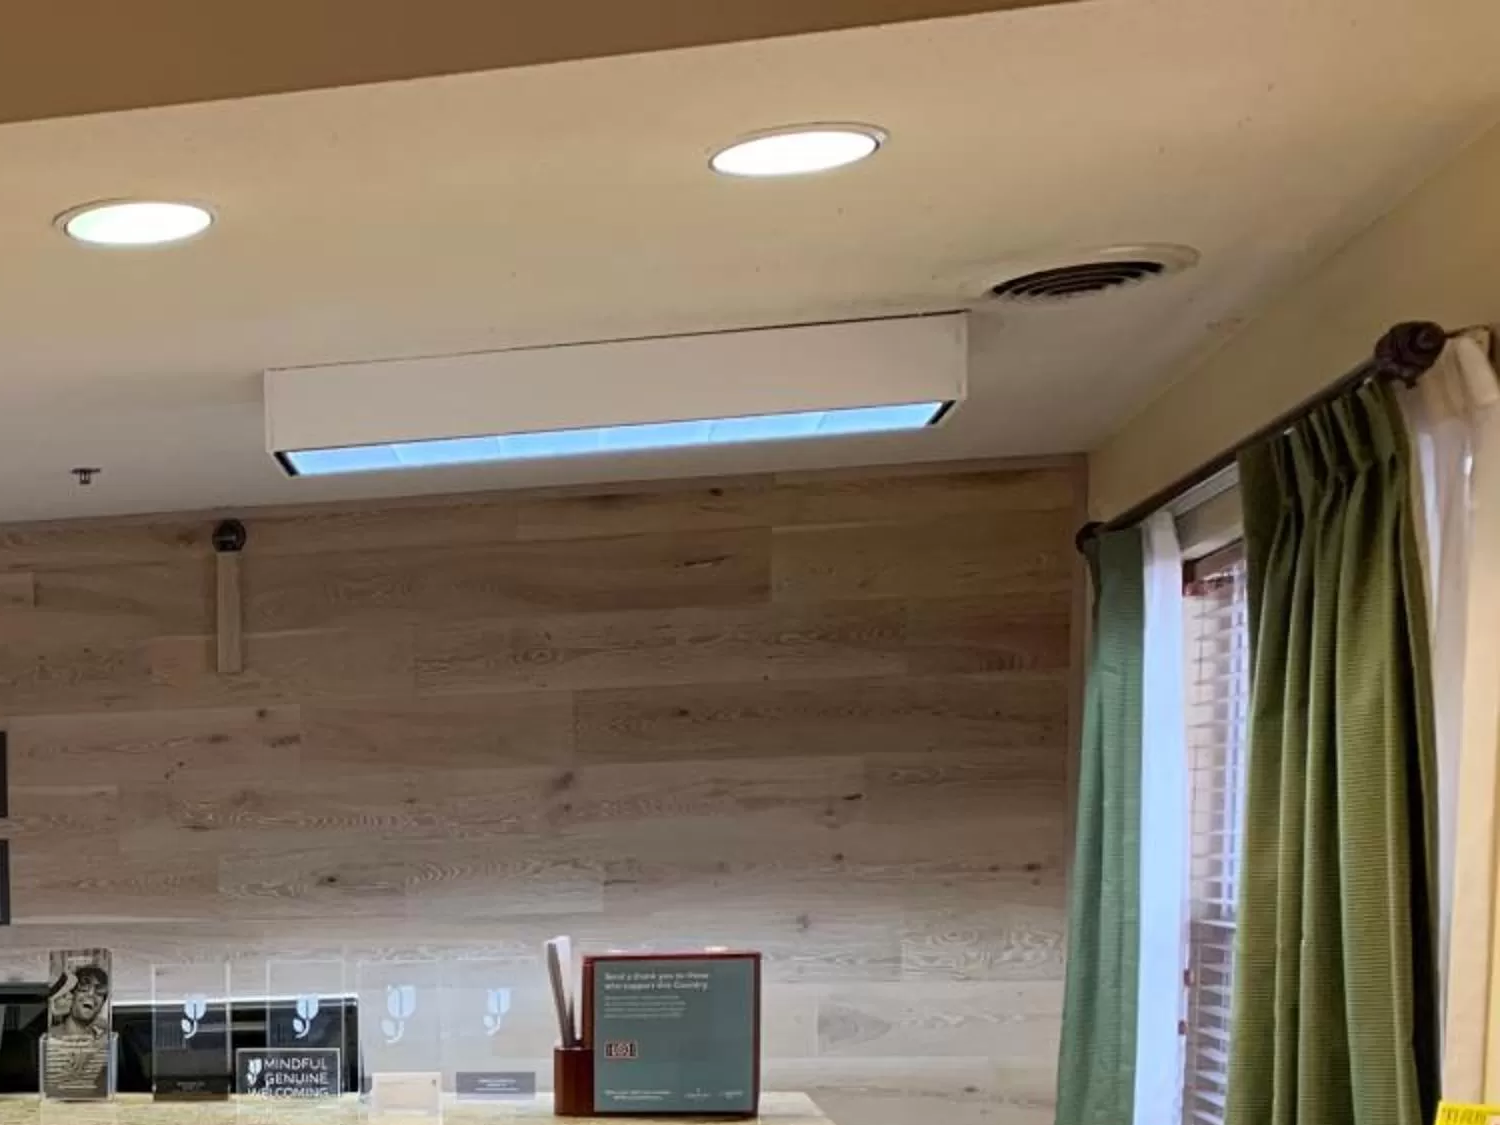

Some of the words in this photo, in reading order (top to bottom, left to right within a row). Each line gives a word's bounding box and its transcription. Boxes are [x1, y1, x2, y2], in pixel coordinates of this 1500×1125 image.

[264, 1058, 328, 1070] MINDFUL
[264, 1072, 330, 1085] GENUINE
[247, 1087, 330, 1097] WELCOMING
